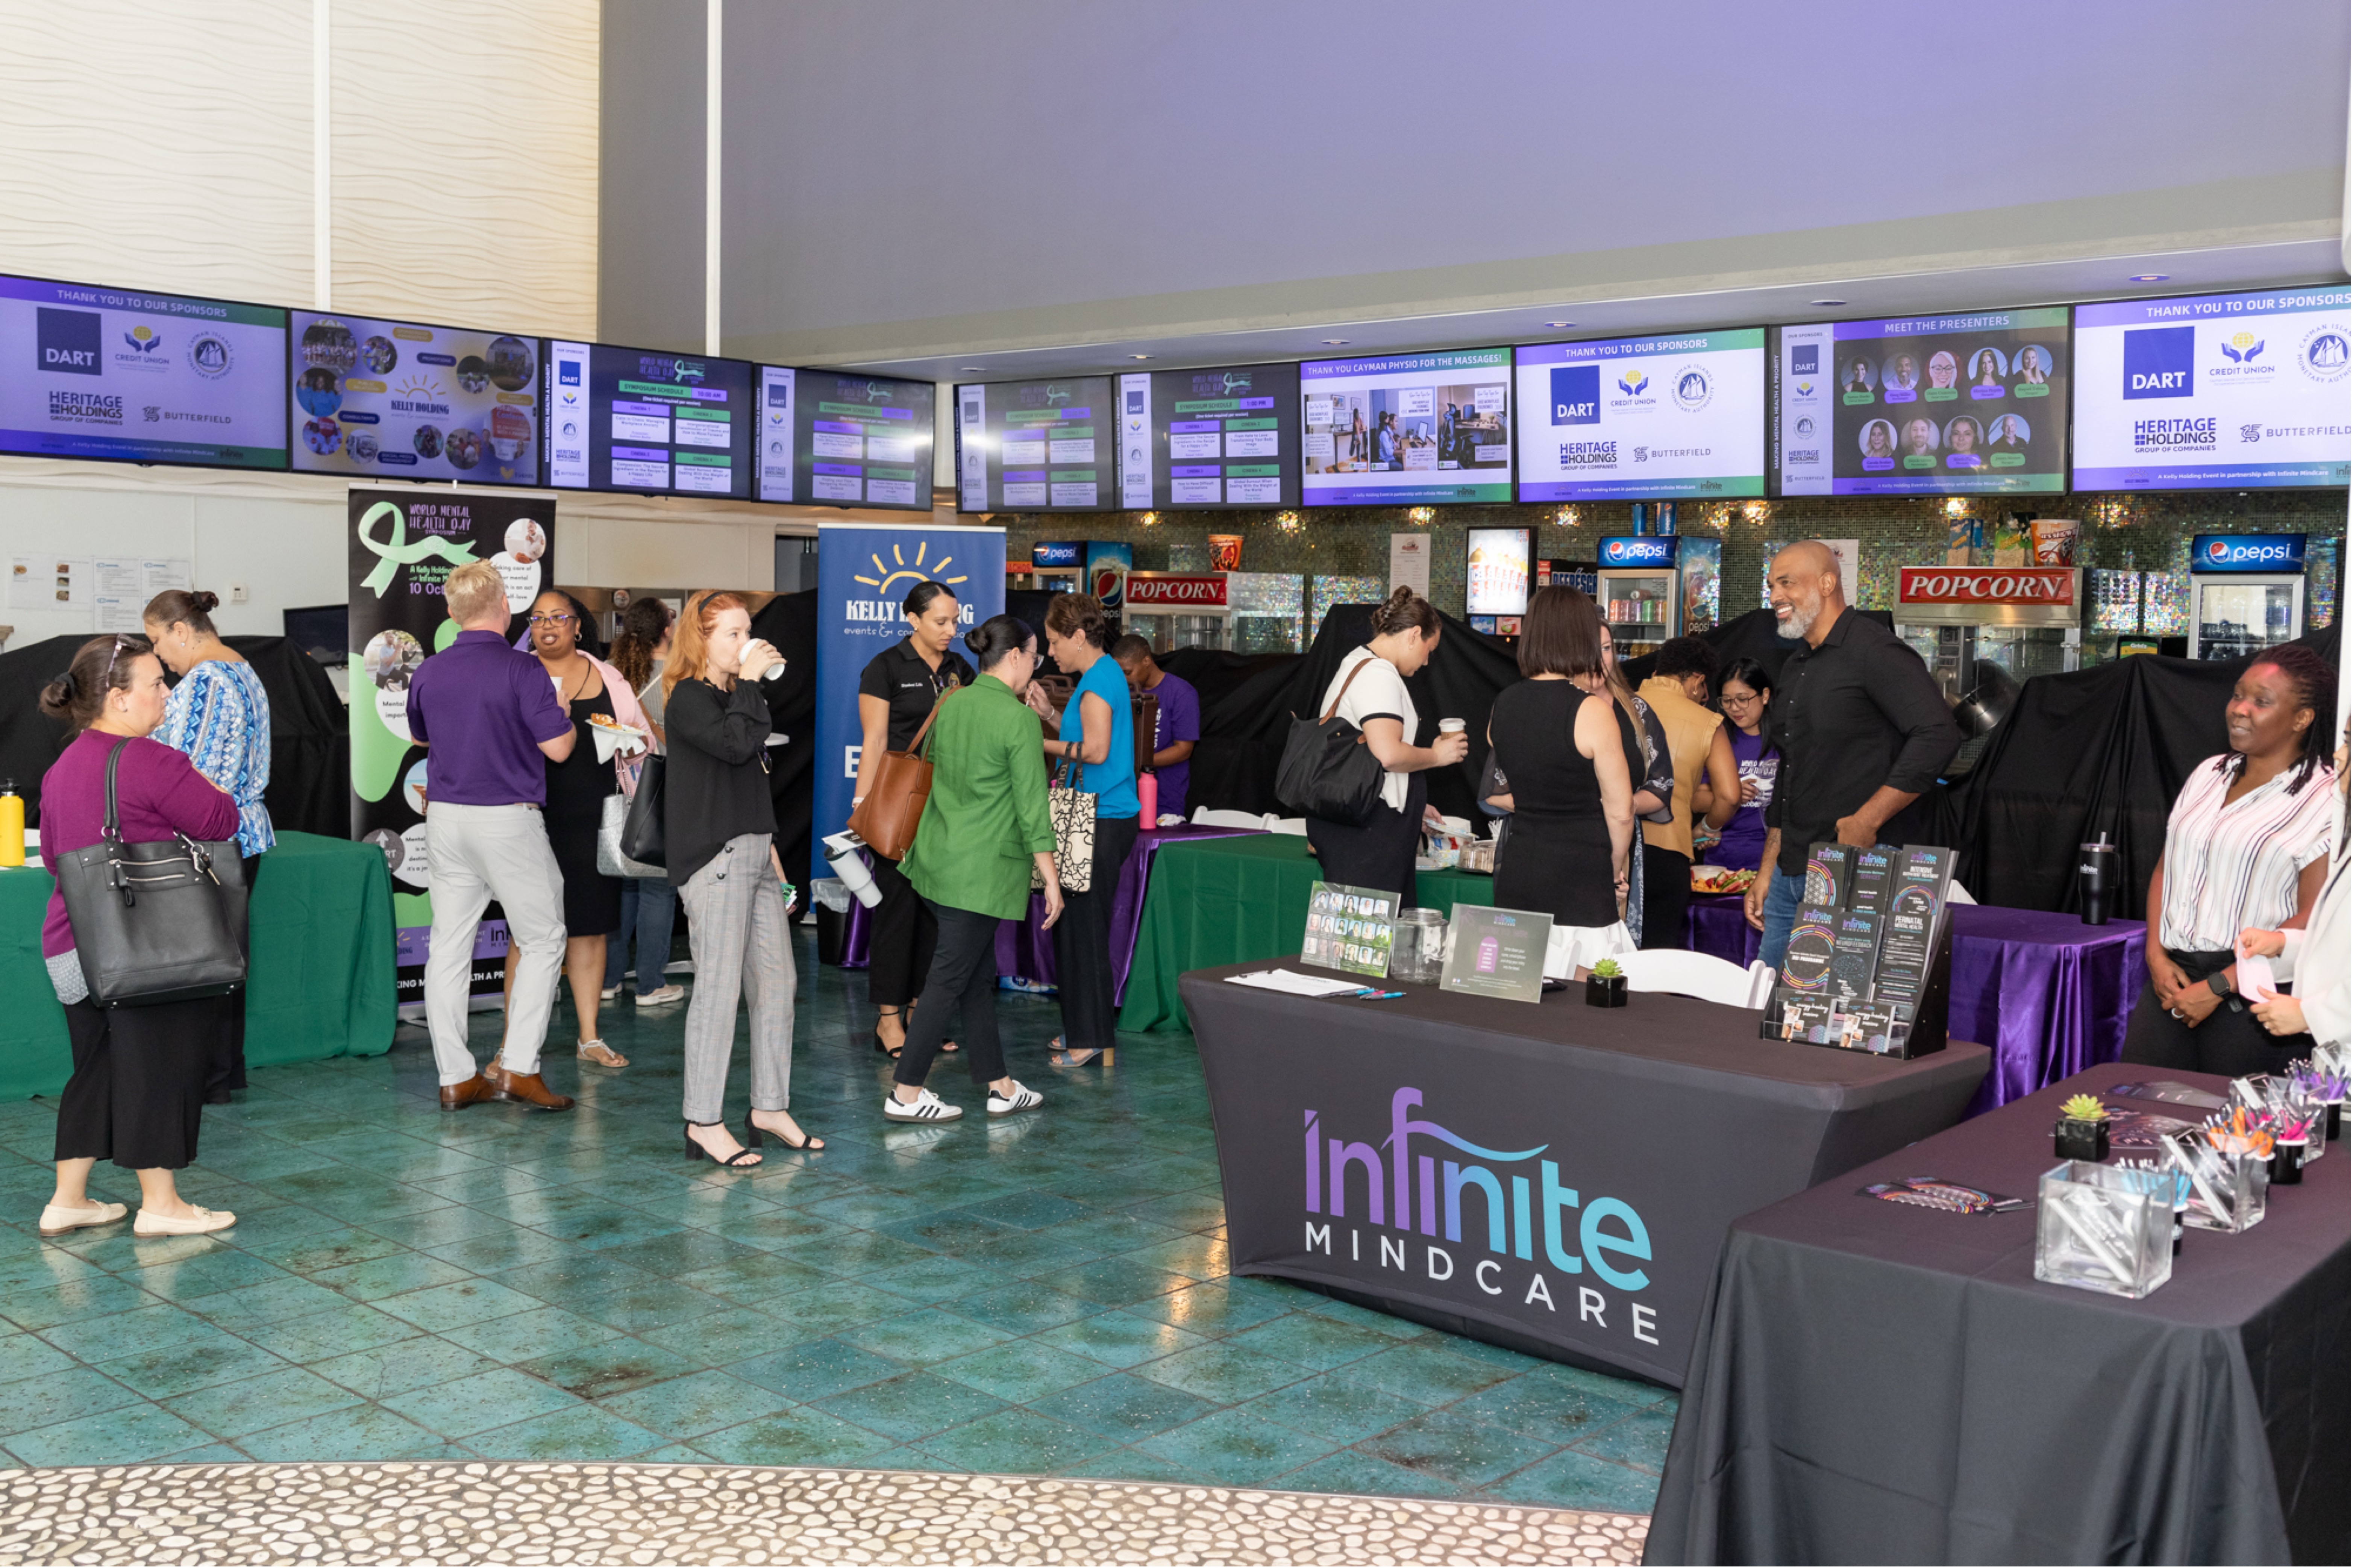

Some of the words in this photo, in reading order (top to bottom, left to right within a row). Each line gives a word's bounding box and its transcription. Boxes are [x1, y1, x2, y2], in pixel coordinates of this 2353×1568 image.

[58, 290, 96, 302] THANK
[100, 295, 123, 305] YOU
[127, 298, 141, 307] TO
[144, 300, 167, 310] OUR
[170, 303, 227, 317] SPONSORS
[2146, 305, 2190, 317] THANK
[2194, 303, 2221, 314] YOU
[2226, 302, 2242, 312] TO
[2247, 299, 2275, 310] OUR
[2279, 293, 2351, 308] SPONSORS
[1885, 323, 1912, 333] MEET
[1916, 321, 1936, 331] THE
[1940, 316, 2009, 329] PRESENTERS
[2299, 324, 2327, 349] CAYMAN
[1566, 348, 1596, 357] THANK
[1598, 346, 1618, 355] YOU
[1621, 344, 1632, 353] TO
[1635, 343, 1654, 352] OUR
[1657, 339, 1707, 351] SPONSORS
[46, 348, 94, 366] DART
[1354, 362, 1386, 372] CAYMAN
[1389, 361, 1418, 369] PHYSIO
[1437, 358, 1452, 366] THE
[1455, 354, 1501, 365] MASSAGES!
[2209, 367, 2240, 376] CREDIT
[2244, 366, 2275, 374] UNION
[2132, 372, 2185, 390] DART
[49, 391, 122, 408] HERITAGE
[391, 400, 414, 411] KELLY
[415, 402, 449, 414] HOLDING
[60, 405, 122, 419] HOLDINGS
[1557, 402, 1594, 417] DART
[164, 412, 231, 423] BUTTERFIELD
[2135, 417, 2216, 433] HERITAGE
[2146, 432, 2216, 445] HOLDINGS
[2266, 426, 2351, 437] BUTTERFIELD
[1560, 441, 1617, 454] HERITAGE
[1651, 449, 1711, 458] BUTTERFIELD
[1569, 453, 1617, 464] HOLDINGS
[409, 504, 436, 515] WORLD
[440, 505, 469, 517] MENTAL
[409, 516, 444, 529] HEALTH
[451, 518, 471, 531] DAY
[1050, 546, 1076, 560] pepsi
[1626, 544, 1667, 559] pepsi
[2233, 543, 2291, 563] pepsi
[410, 565, 415, 573] A
[416, 565, 430, 575] Kelly
[409, 582, 421, 594] 10
[1130, 581, 1220, 599] POPCORN
[1907, 575, 2066, 597] POPCORN
[846, 600, 896, 622] KELLY
[844, 625, 877, 635] events
[1689, 622, 1710, 634] pepsi
[1305, 1222, 1659, 1345] MINDCARE
